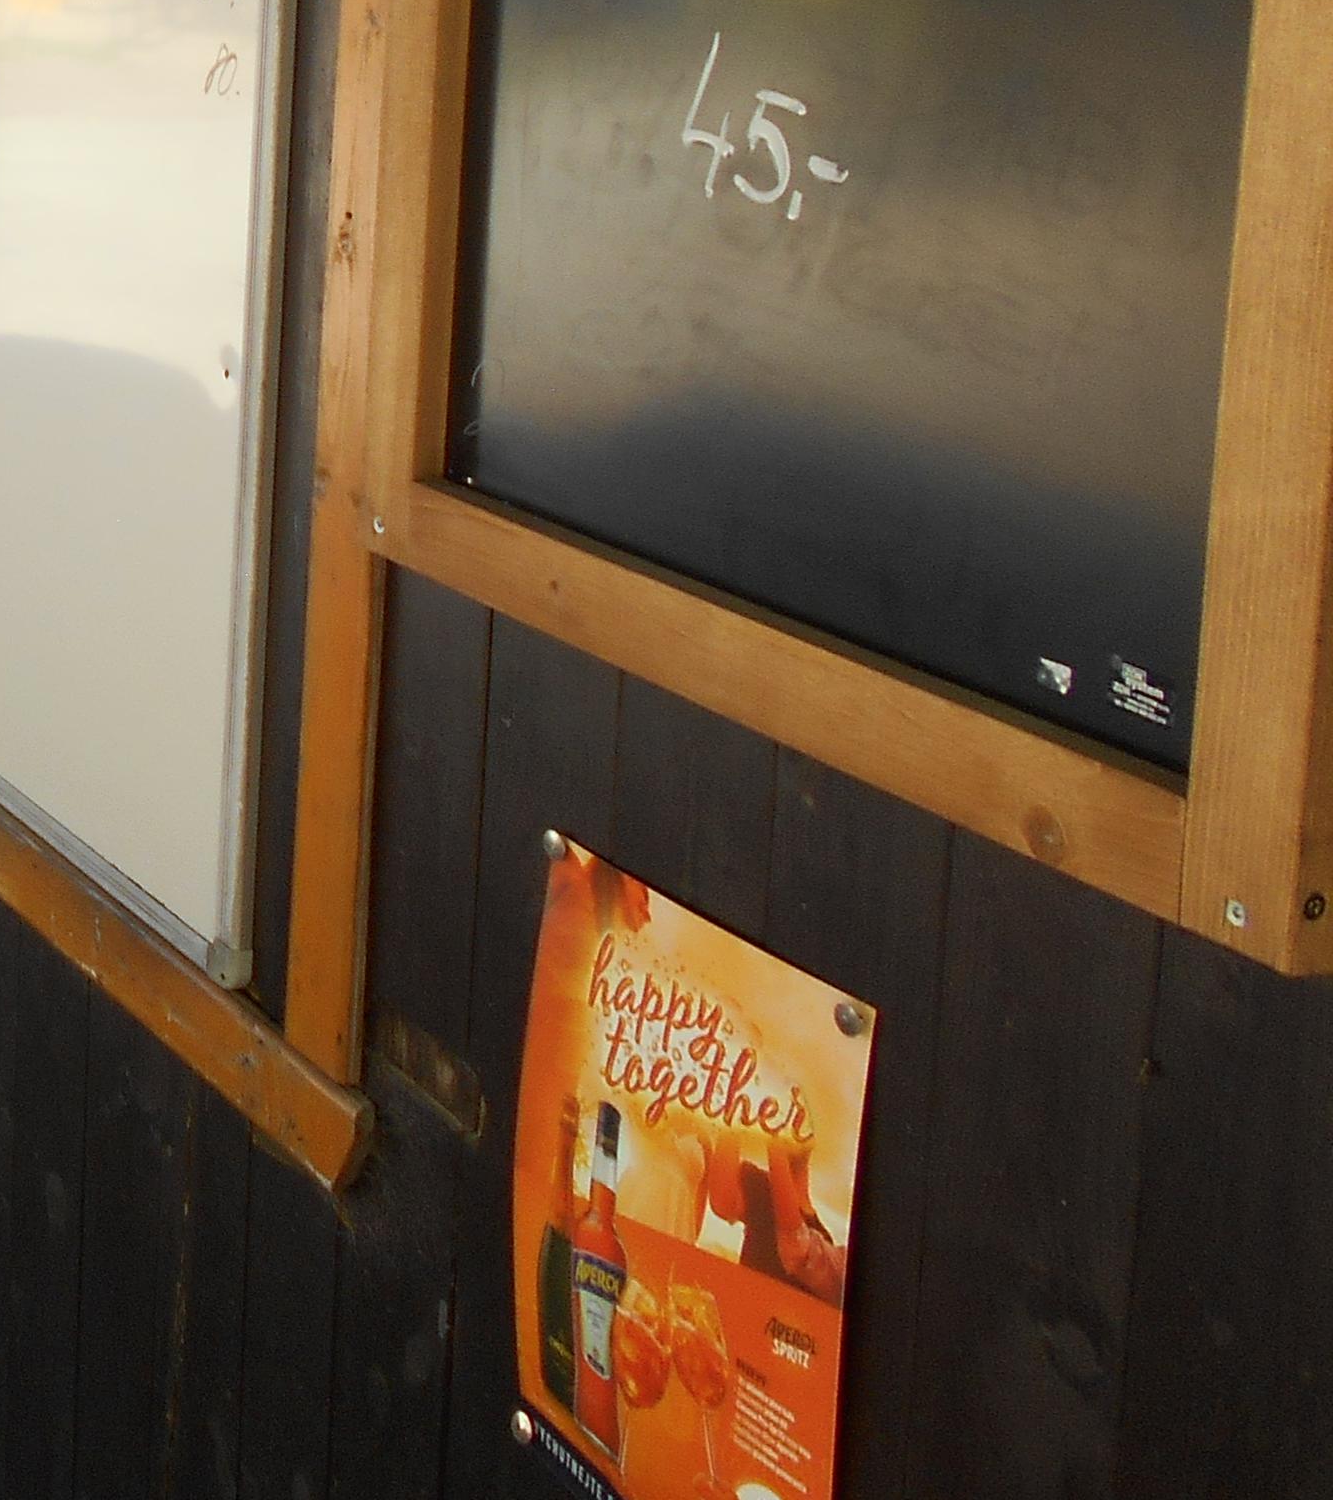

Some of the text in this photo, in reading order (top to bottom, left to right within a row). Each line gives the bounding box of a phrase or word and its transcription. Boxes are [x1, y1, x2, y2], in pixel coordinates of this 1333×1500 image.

[682, 32, 849, 220] 45,-
[588, 932, 728, 1062] happy
[601, 1018, 815, 1144] together
[772, 1337, 810, 1369] SPRITZ
